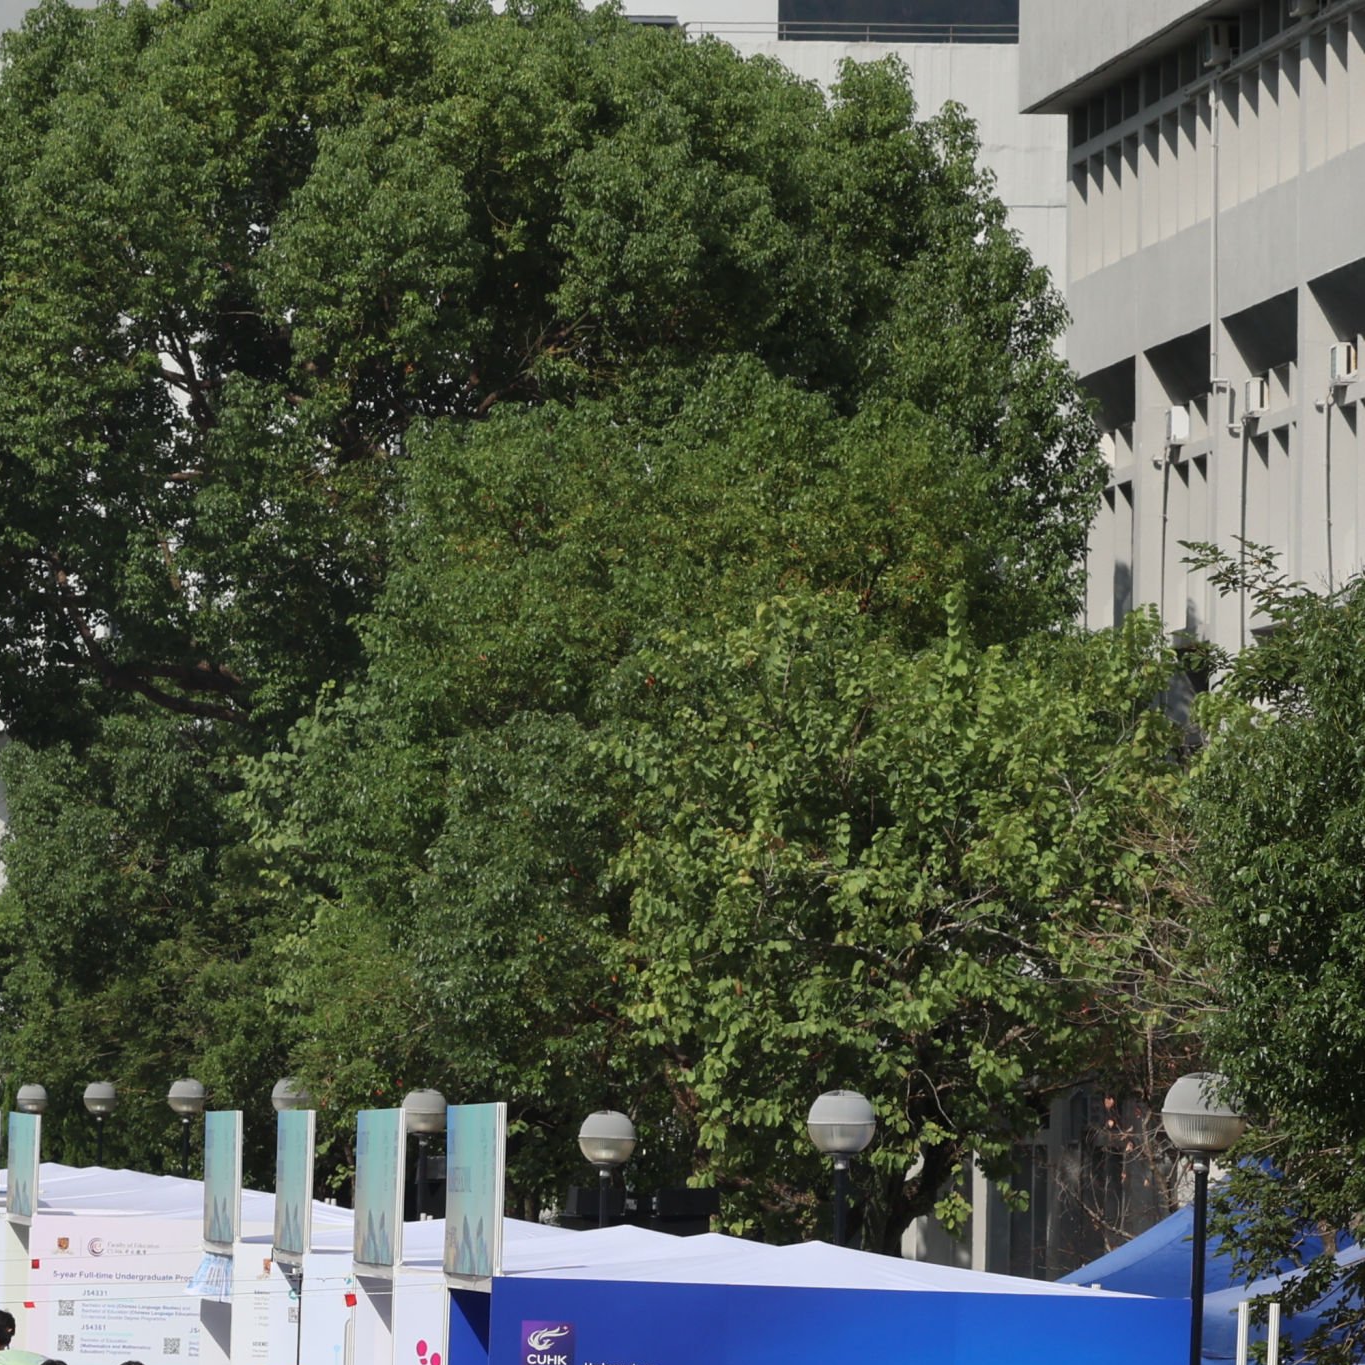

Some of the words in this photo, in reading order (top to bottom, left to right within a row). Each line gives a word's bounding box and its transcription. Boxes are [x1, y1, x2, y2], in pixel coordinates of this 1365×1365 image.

[53, 1270, 77, 1280] 5-year
[79, 1271, 113, 1280] Full-time
[115, 1272, 173, 1282] Undergraduate
[527, 1354, 567, 1365] CUHK
